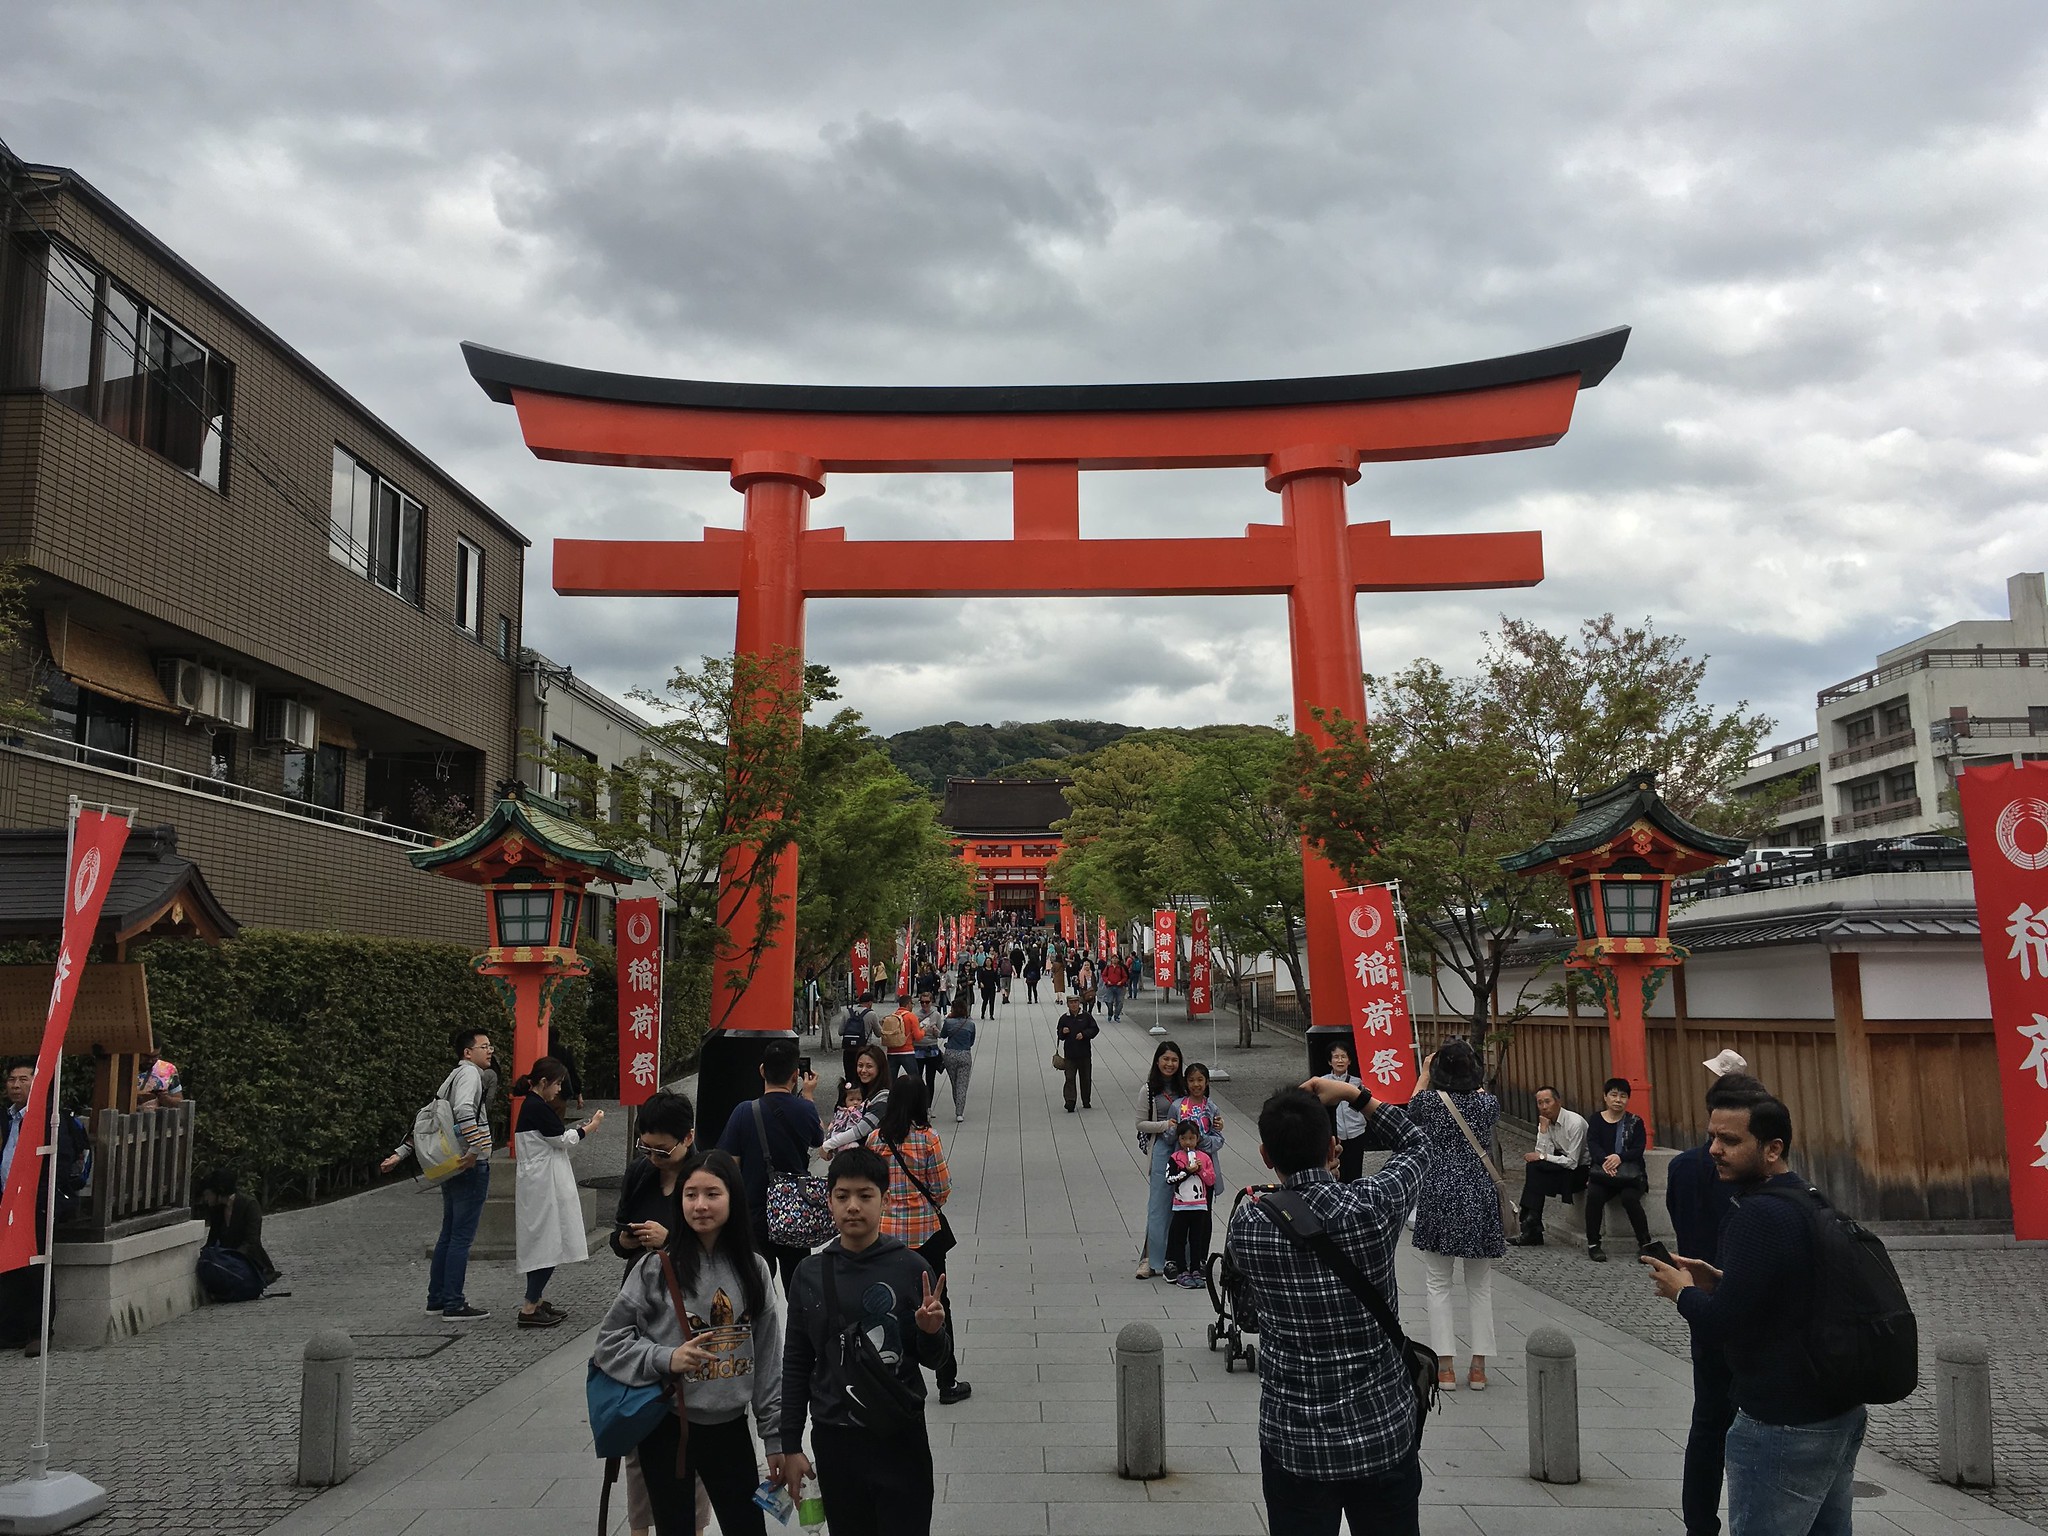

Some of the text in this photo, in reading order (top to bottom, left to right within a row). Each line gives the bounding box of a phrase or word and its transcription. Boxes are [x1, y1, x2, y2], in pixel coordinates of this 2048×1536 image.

[627, 957, 655, 1087] 稲荷祭
[1192, 939, 1205, 1005] 稲荷祭
[1353, 950, 1403, 1086] 稲荷祭
